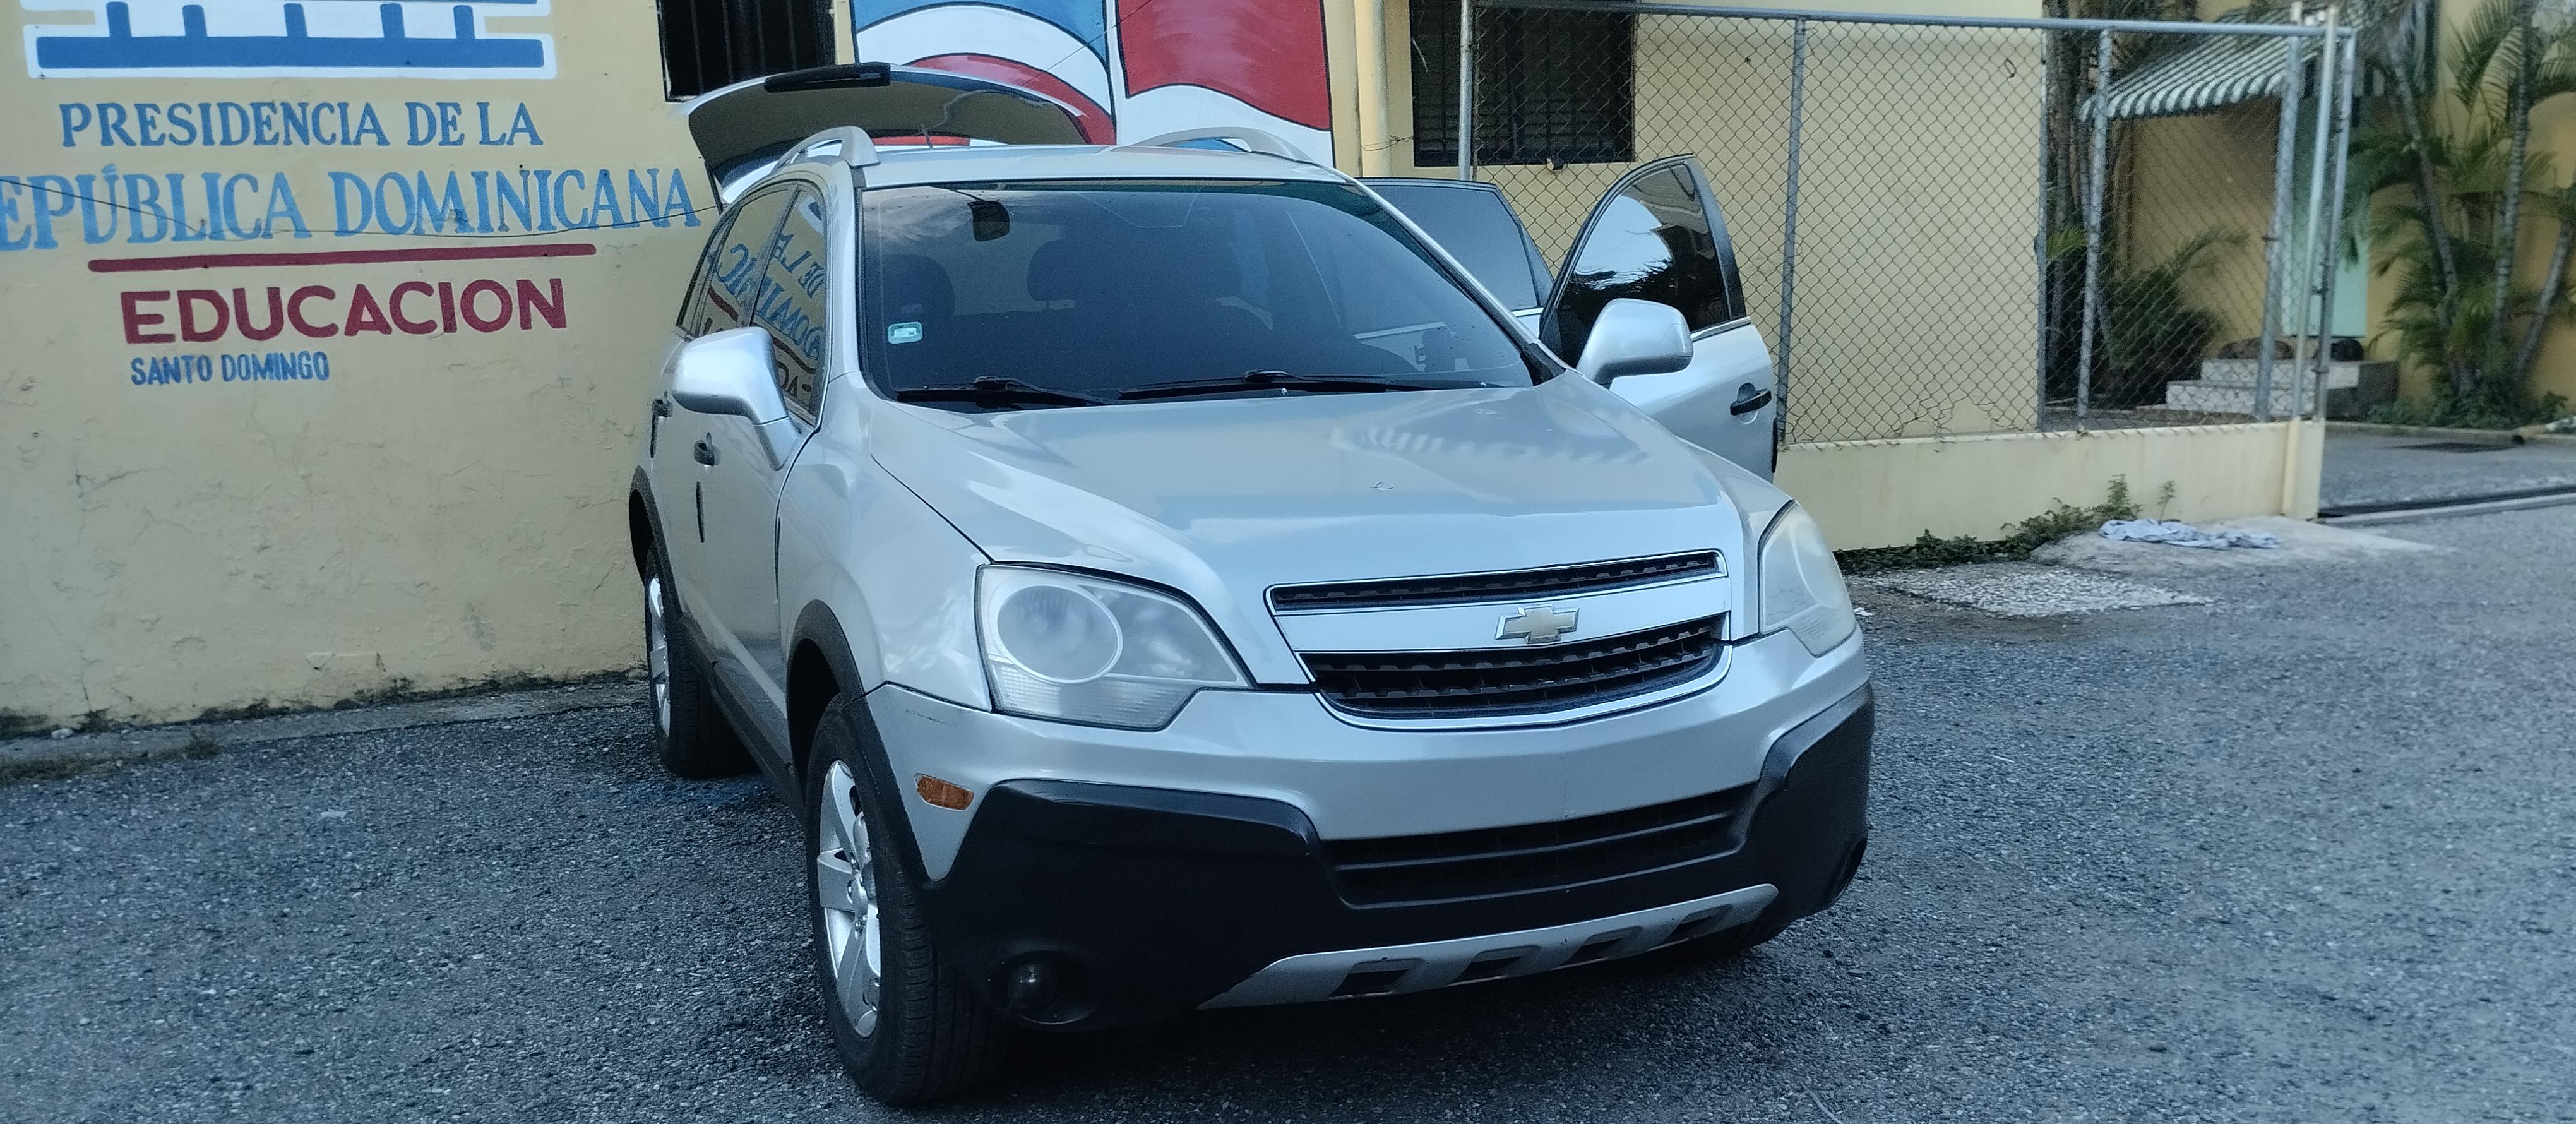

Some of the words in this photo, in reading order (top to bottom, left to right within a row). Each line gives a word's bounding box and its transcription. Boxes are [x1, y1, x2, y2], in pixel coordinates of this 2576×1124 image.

[59, 102, 390, 147] PRESIDENCIA
[405, 102, 465, 146] DE
[477, 102, 544, 146] LA
[328, 168, 701, 236] DOMINICANA
[120, 278, 568, 345] EDUCACION
[131, 354, 213, 386] SANTO
[221, 350, 330, 383] DOMINGO
